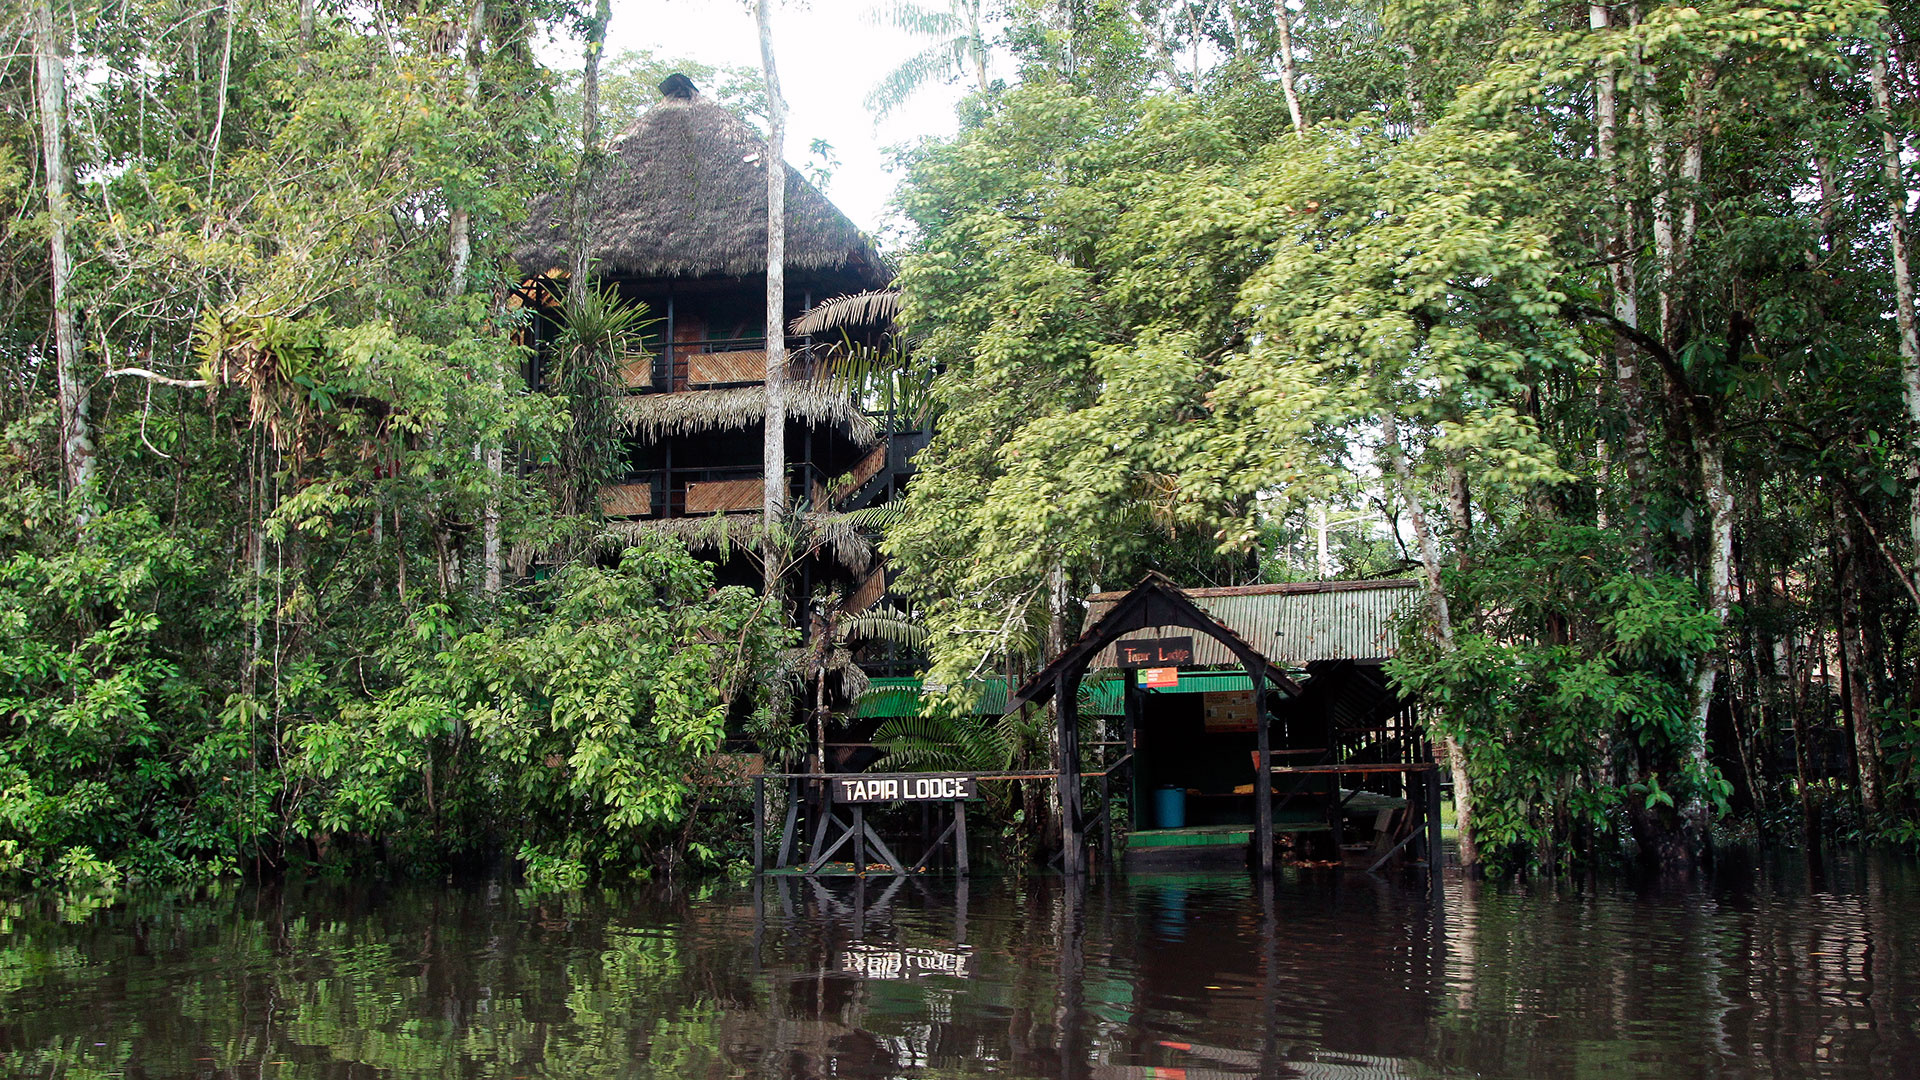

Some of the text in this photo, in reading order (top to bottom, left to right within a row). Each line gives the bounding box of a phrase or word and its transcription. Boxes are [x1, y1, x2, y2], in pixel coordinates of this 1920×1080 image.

[1124, 647, 1190, 665] Tapir Lodge
[841, 777, 969, 801] TAPIR LODGE
